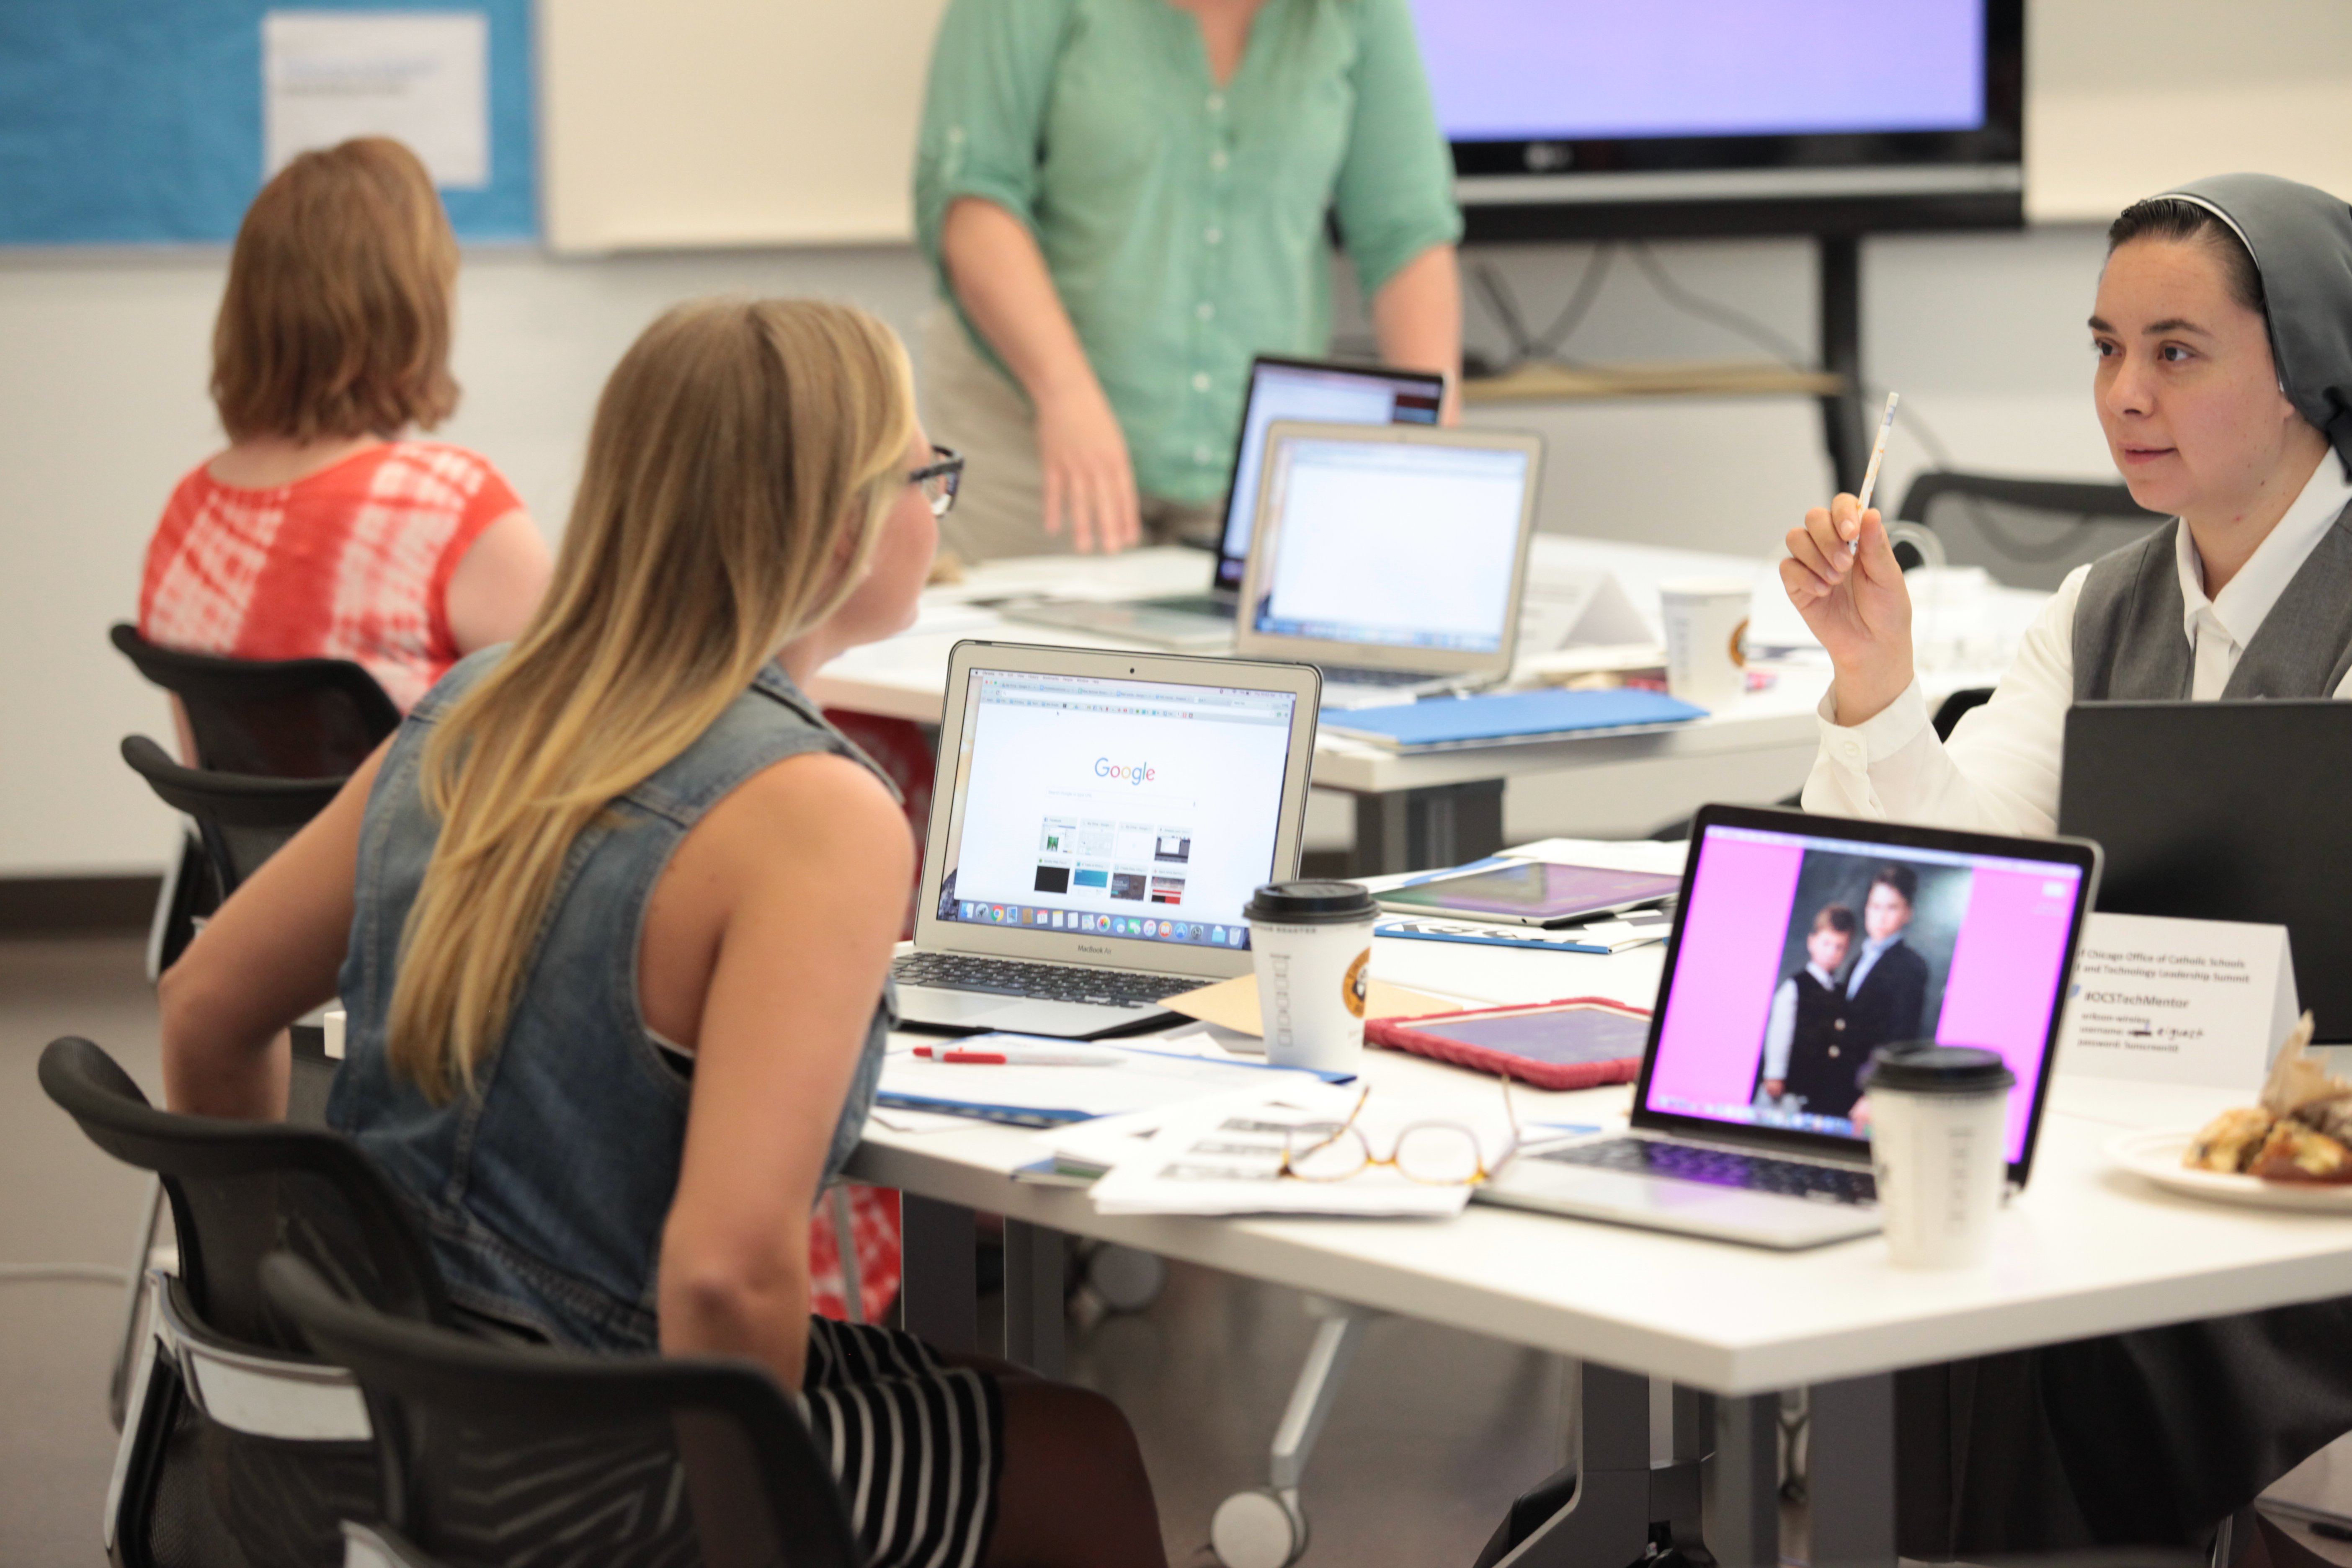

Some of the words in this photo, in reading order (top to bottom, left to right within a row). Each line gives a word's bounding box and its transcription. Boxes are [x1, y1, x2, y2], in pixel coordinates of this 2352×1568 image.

[1095, 757, 1155, 785] Google
[1077, 945, 1103, 954] MacBook
[2087, 949, 2123, 962] Chicago
[2125, 952, 2153, 962] Office
[2156, 954, 2166, 962] of
[2168, 954, 2205, 966] Catholic
[2210, 957, 2245, 968] Schools
[2084, 965, 2100, 973] and
[2104, 965, 2156, 979] Technology
[2159, 970, 2209, 982] Leadership
[2213, 973, 2249, 983] Summit
[2084, 991, 2188, 1008] #OCSTechMentor
